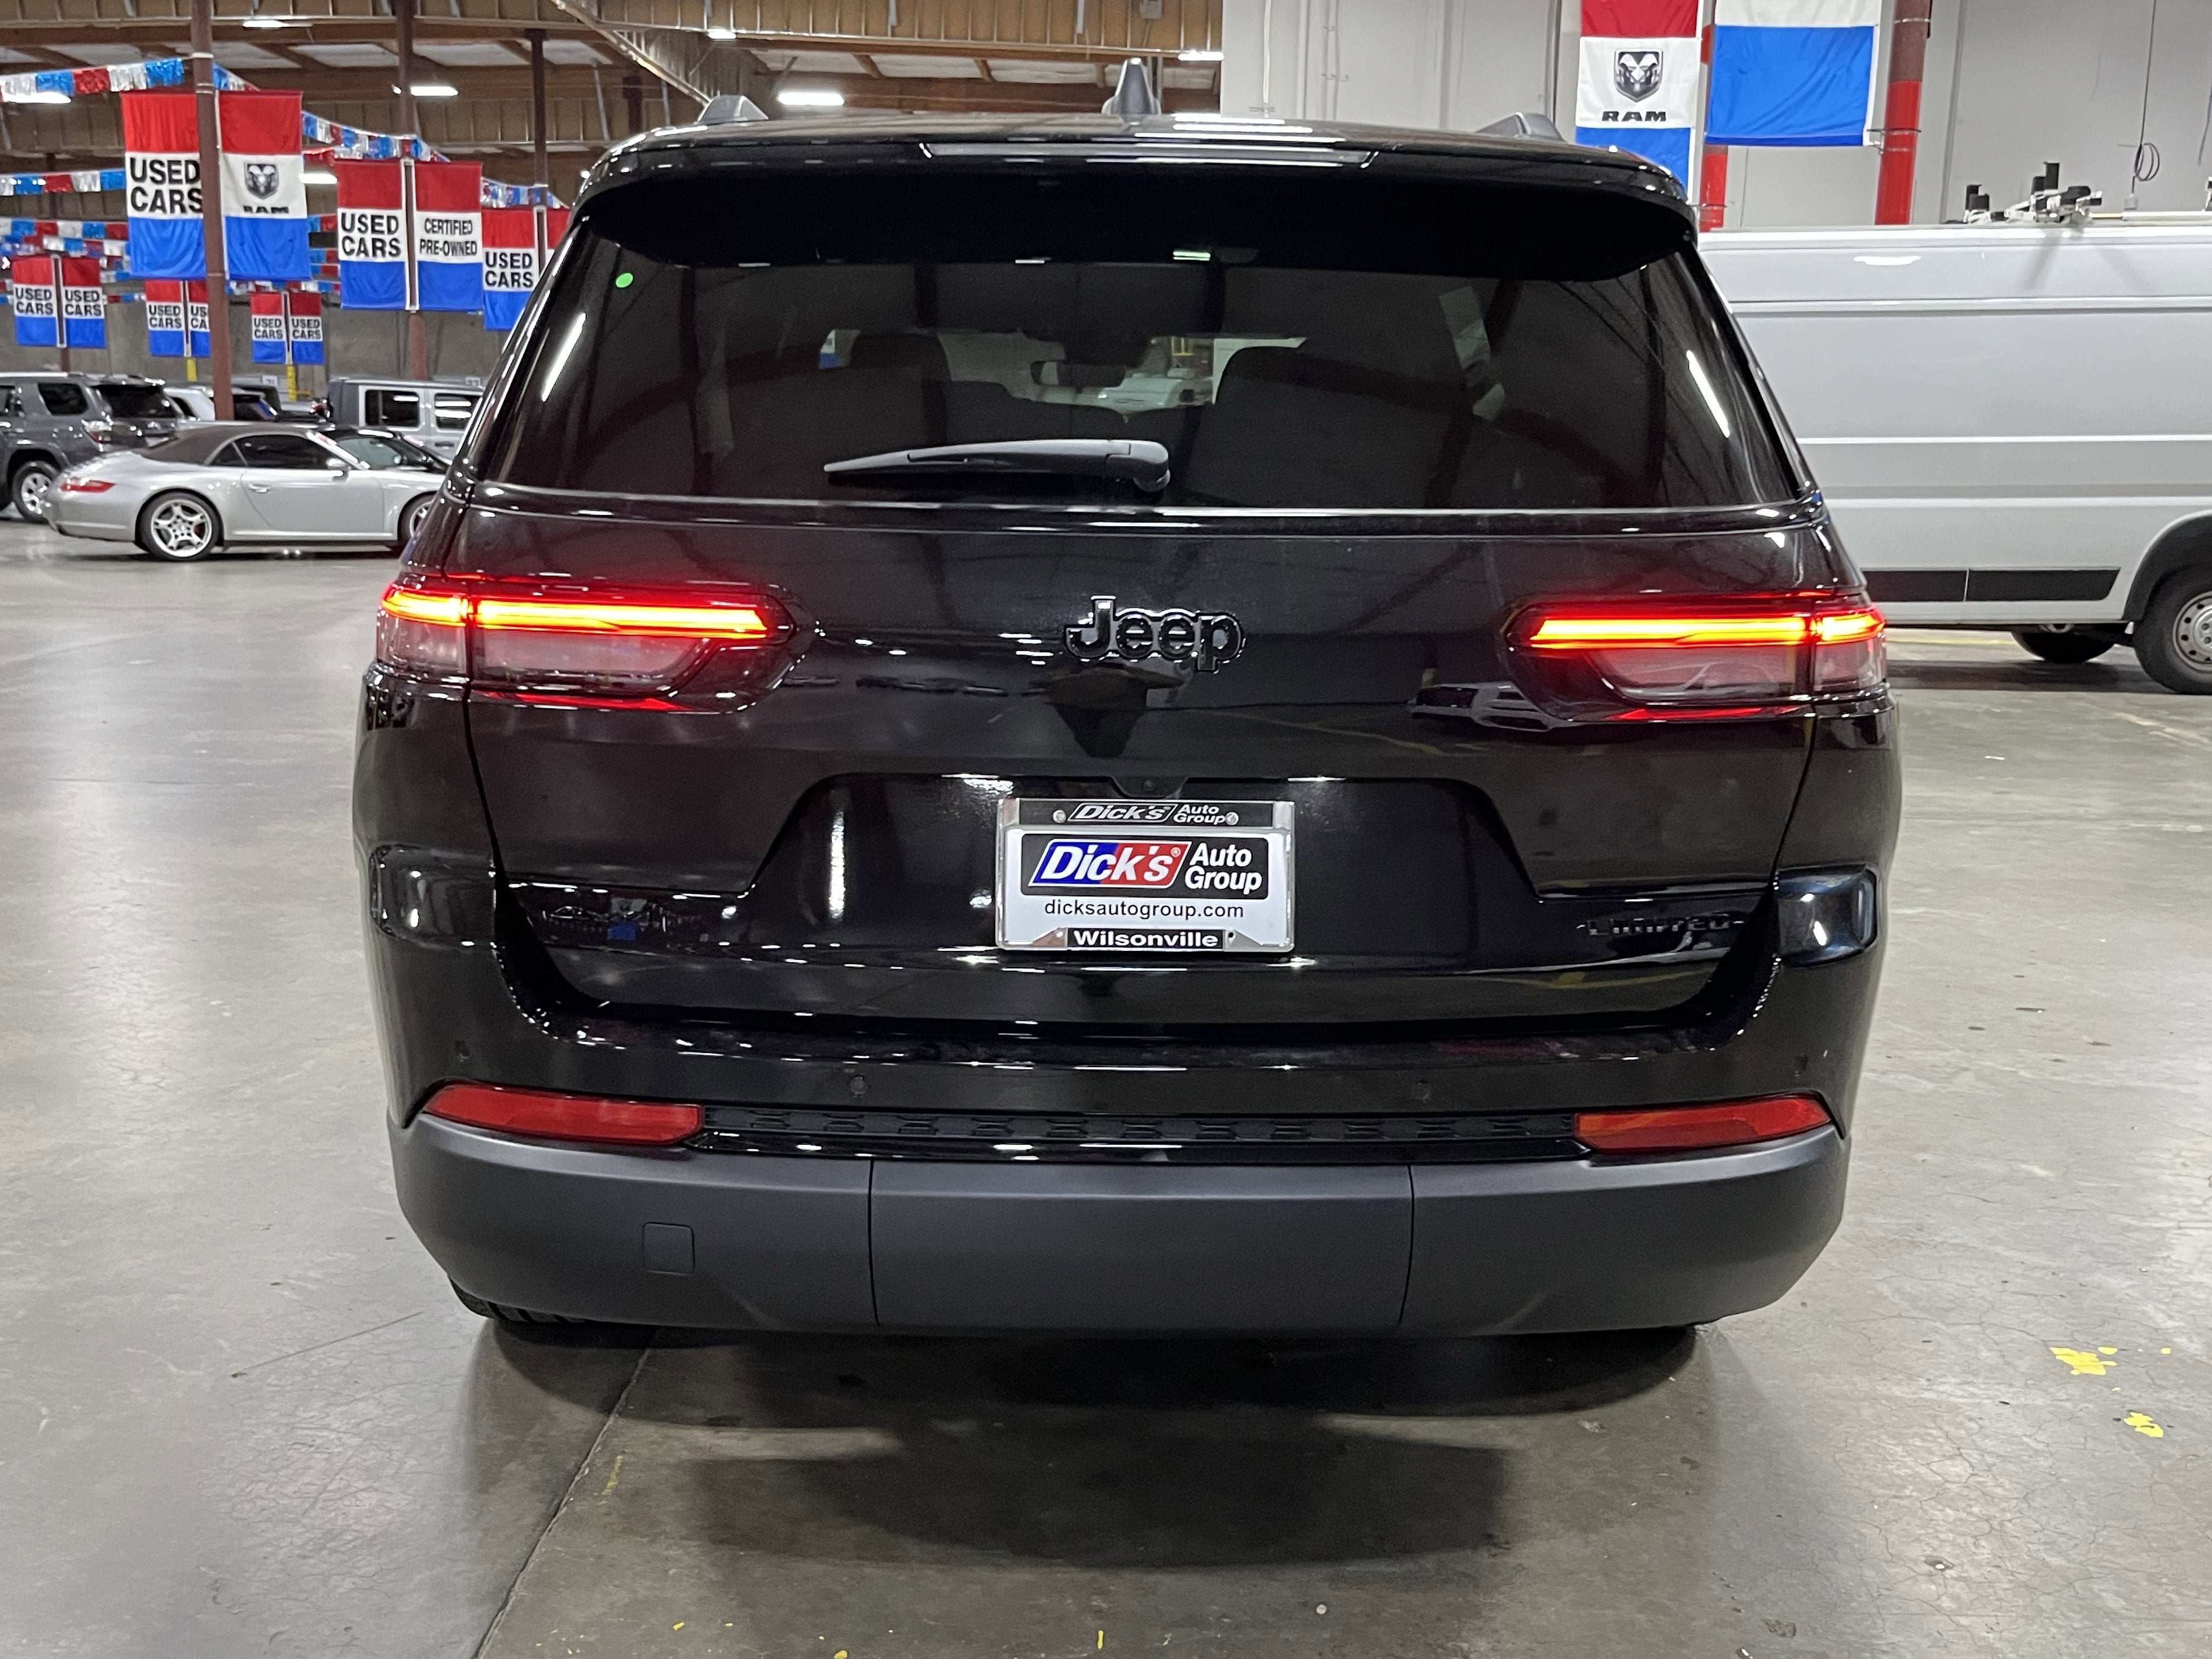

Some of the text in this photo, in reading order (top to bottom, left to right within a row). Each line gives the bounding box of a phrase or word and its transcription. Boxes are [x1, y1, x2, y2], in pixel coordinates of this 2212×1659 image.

[1601, 110, 1666, 122] RAM
[129, 157, 200, 184] USED
[131, 187, 202, 213] CARS
[341, 212, 399, 234] USED
[424, 218, 472, 235] CERTIFIED
[341, 236, 401, 257] CARS
[420, 239, 477, 256] PRE-OWNED
[485, 251, 533, 269] USED
[485, 270, 533, 288] CARS
[15, 287, 52, 301] USED
[65, 290, 100, 303] USED
[16, 302, 53, 315] CARS
[65, 303, 101, 317] CARS
[149, 304, 181, 317] USED
[190, 305, 207, 317] US
[149, 317, 182, 329] CARS
[190, 318, 207, 329] CA
[254, 318, 282, 329] USED
[291, 318, 320, 329] USED
[254, 329, 283, 339] CARS
[292, 329, 321, 339] CARS
[1066, 597, 1243, 671] Jeep
[1177, 804, 1219, 815] Auto
[1173, 813, 1226, 825] Group
[1189, 843, 1251, 867] Auto
[1185, 866, 1262, 894] Group
[1045, 900, 1244, 920] dicksautogroup.com
[1073, 930, 1219, 947] Wilsonville
